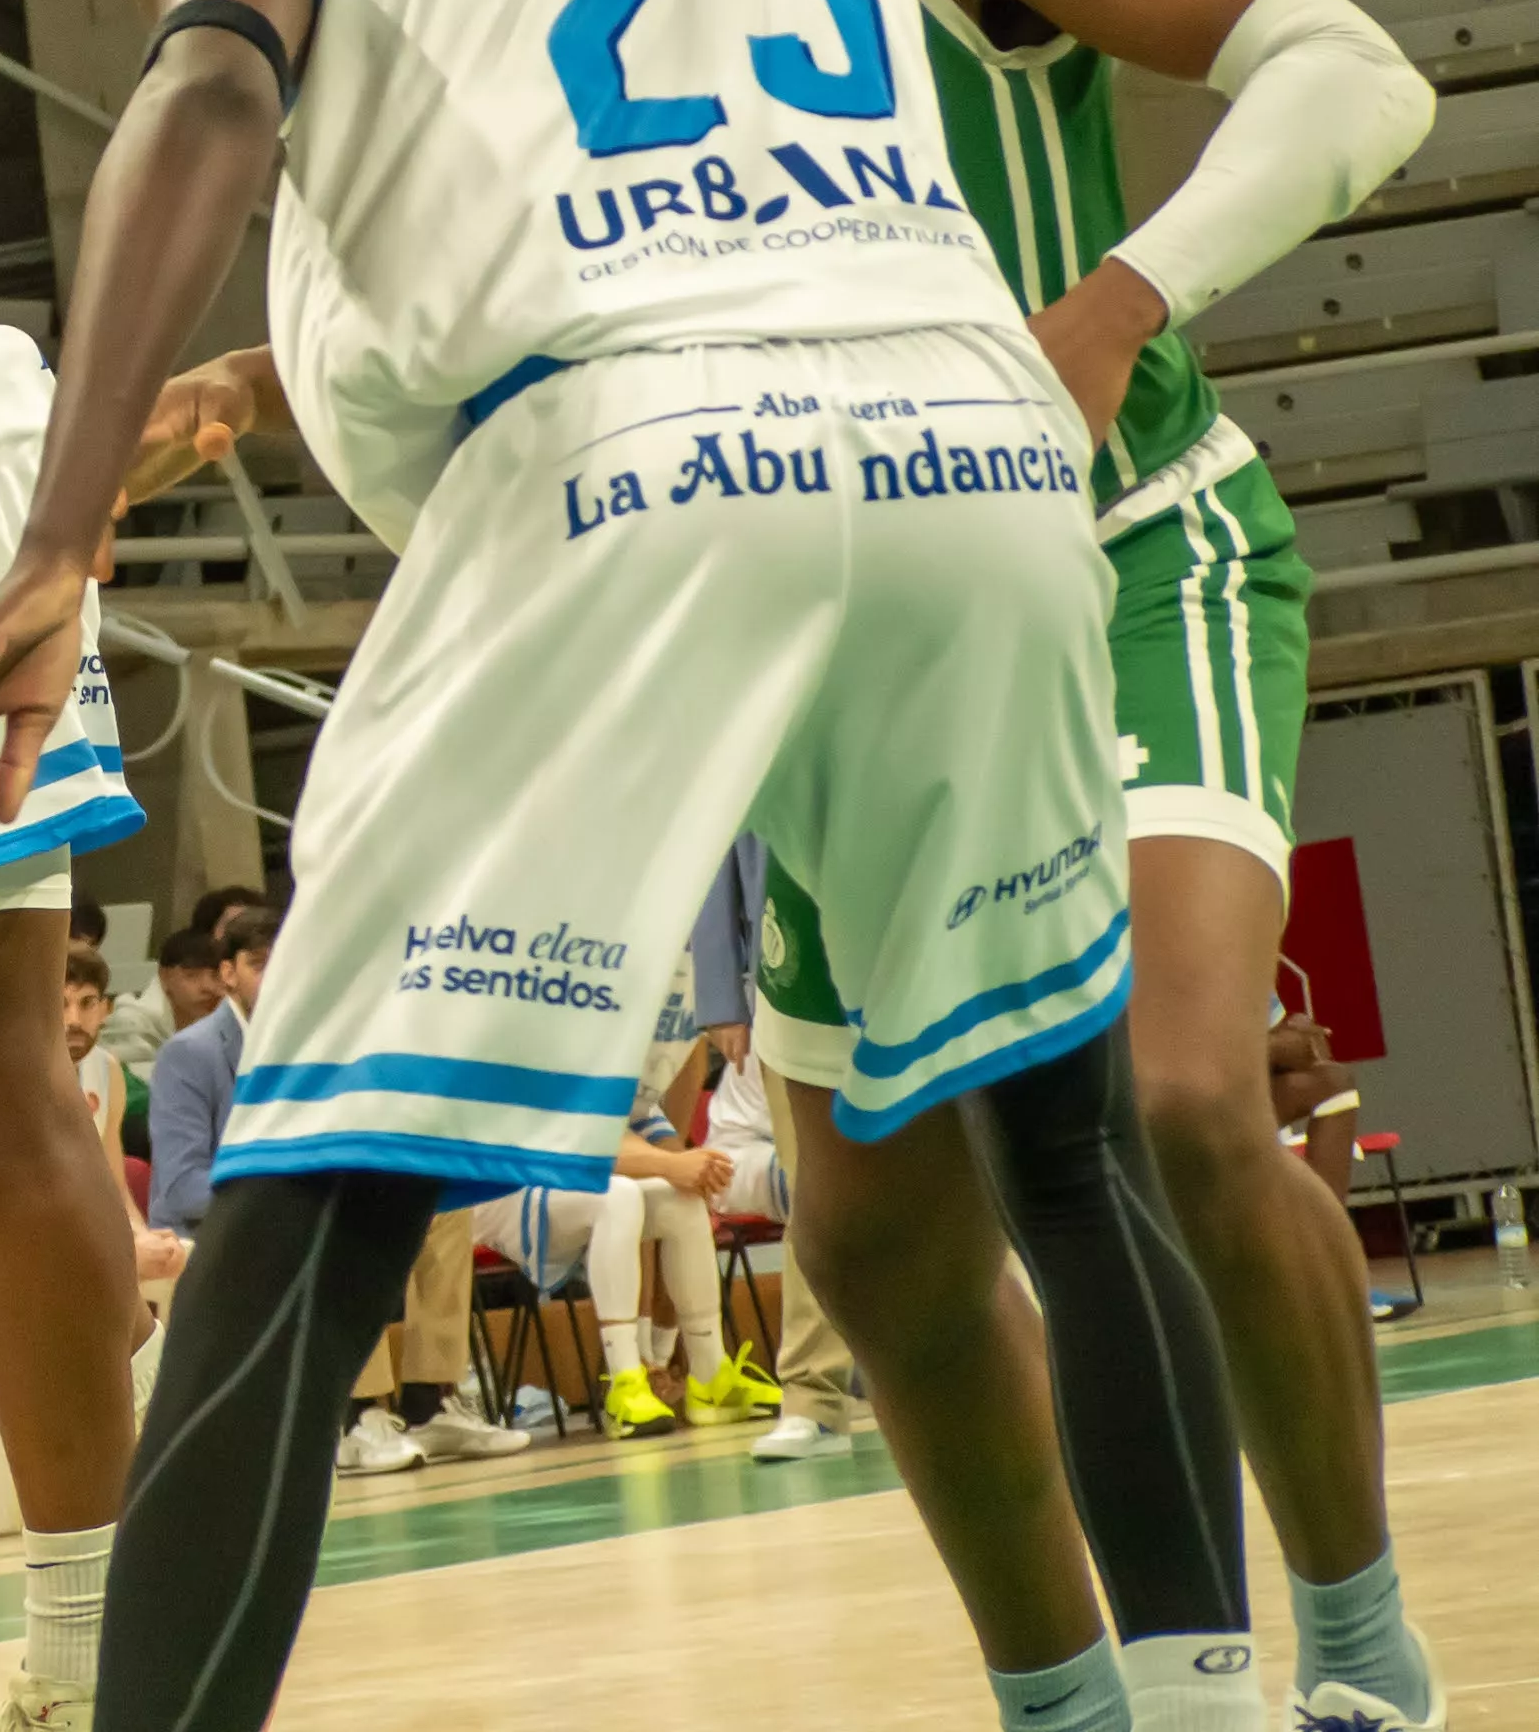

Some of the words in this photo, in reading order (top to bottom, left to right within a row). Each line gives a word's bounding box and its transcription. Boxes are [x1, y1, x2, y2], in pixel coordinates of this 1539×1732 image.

[714, 236, 753, 255] DE
[562, 465, 651, 541] La
[527, 922, 629, 971] eleva
[441, 966, 622, 1013] sentidos.
